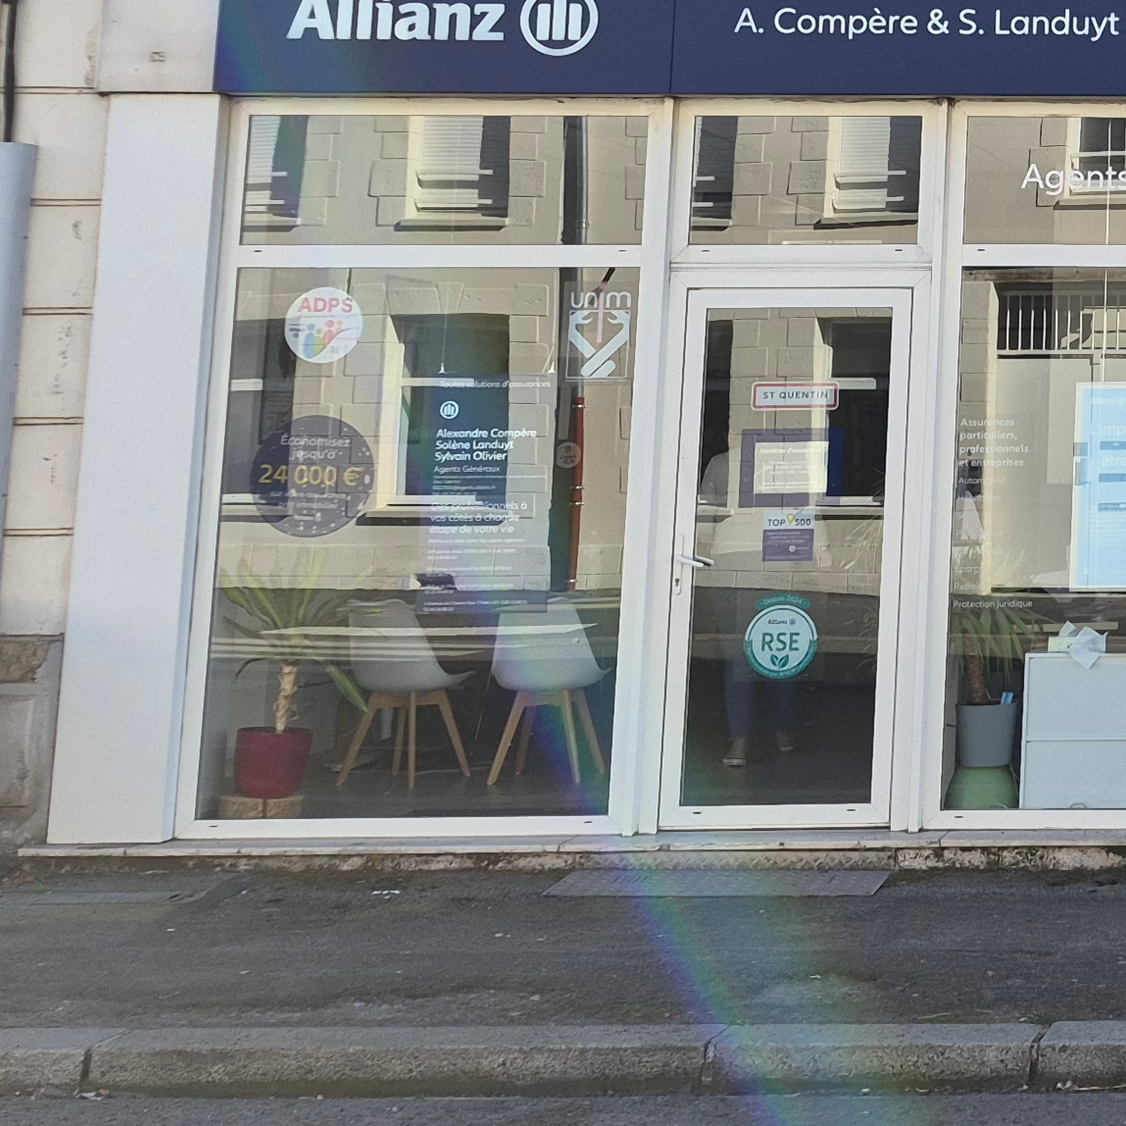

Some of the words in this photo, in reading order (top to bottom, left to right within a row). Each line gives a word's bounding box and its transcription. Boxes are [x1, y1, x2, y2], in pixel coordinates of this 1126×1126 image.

[734, 8, 765, 35] A.
[773, 7, 919, 40] Compère
[927, 9, 950, 34] &
[958, 9, 985, 36] S.
[994, 8, 1120, 42] Landuyt
[297, 296, 354, 314] ADPS
[762, 390, 776, 400] ST
[779, 389, 829, 401] QUENTIN
[960, 417, 1015, 427] Assurances
[280, 432, 351, 448] Économisez
[435, 427, 489, 439] Alexandre
[490, 427, 538, 441] Compère
[959, 430, 1018, 441] particuliers,
[435, 439, 471, 450] Solène
[472, 439, 514, 451] Landuyt
[959, 444, 1029, 455] professionnels
[433, 451, 472, 463] Sylvain
[472, 450, 507, 461] Olivier
[971, 458, 1025, 468] entreprises
[258, 463, 290, 485] 24
[293, 464, 338, 486] 000
[766, 518, 787, 527] TOP
[794, 518, 812, 526] 500
[953, 598, 996, 608] Protection
[760, 631, 802, 652] RSE
